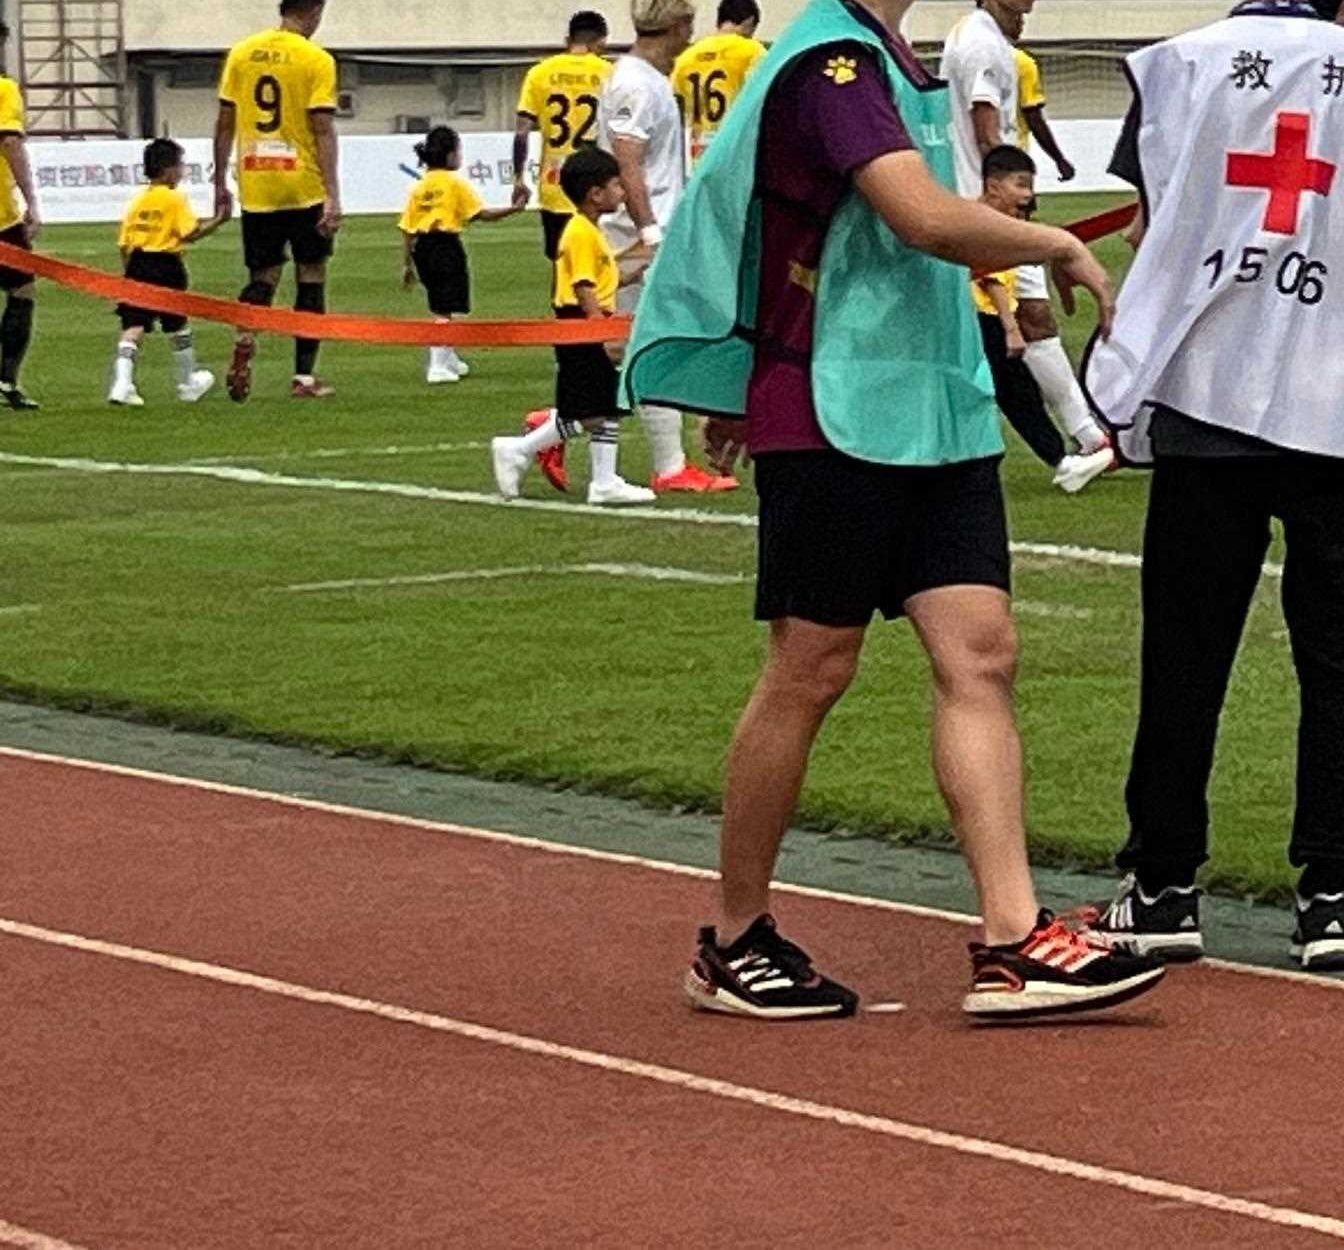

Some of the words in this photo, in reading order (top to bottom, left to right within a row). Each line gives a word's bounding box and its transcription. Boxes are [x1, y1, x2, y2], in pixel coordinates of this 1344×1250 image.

[254, 75, 281, 133] 9
[545, 94, 598, 148] 32
[687, 70, 727, 124] 16
[1203, 246, 1328, 305] 1506
